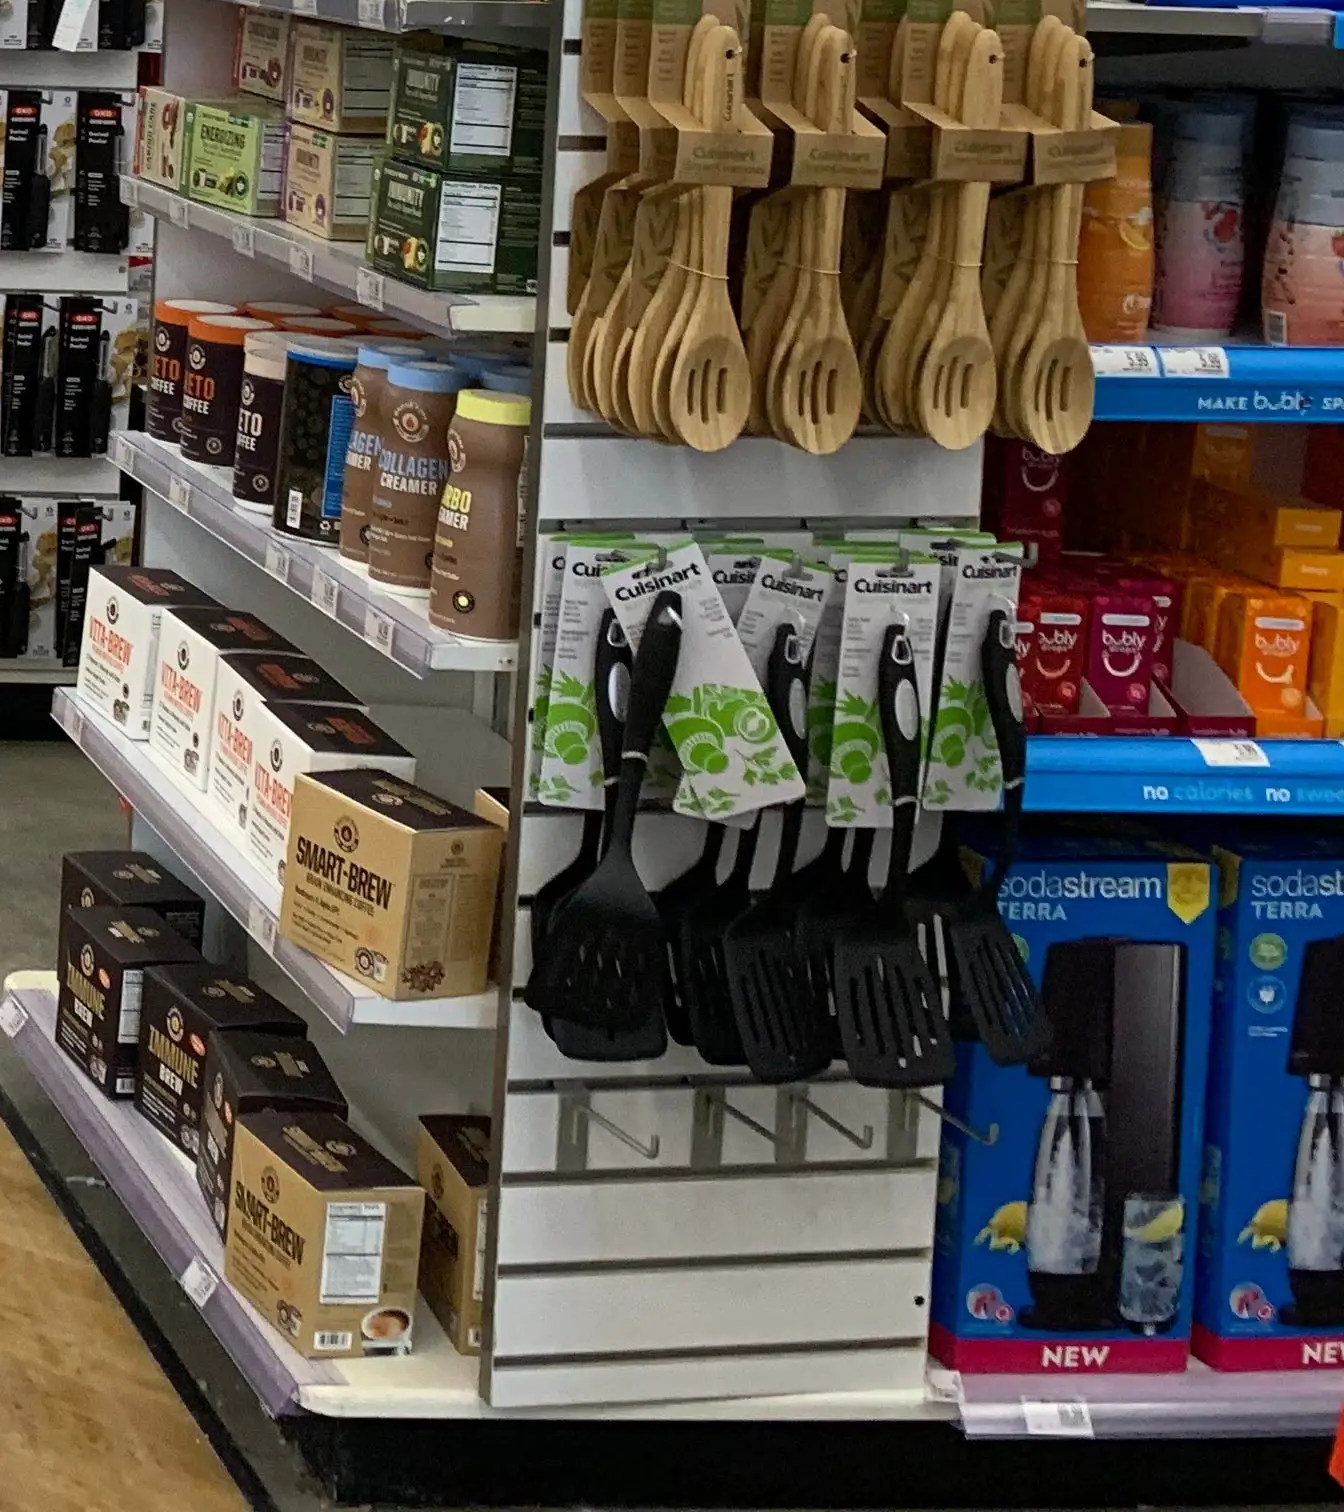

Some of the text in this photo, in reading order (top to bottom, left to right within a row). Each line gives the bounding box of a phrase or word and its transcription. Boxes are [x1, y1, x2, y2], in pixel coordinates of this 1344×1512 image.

[153, 355, 180, 380] ETO
[1198, 396, 1248, 410] MAKE
[380, 473, 437, 496] CREAMER
[615, 562, 701, 601] Cuisinart
[962, 564, 1018, 579] Cuisinart
[761, 574, 824, 602] Cuisinart
[854, 578, 932, 595] Cuisinart
[1103, 629, 1147, 649] bubly
[1255, 633, 1300, 651] bubly
[218, 711, 253, 766] VITA-BRE
[1143, 785, 1169, 800] no
[1174, 781, 1253, 801] calories
[1265, 788, 1291, 802] no
[296, 834, 392, 912] SMART-BREW
[999, 869, 1162, 900] sodastream
[998, 901, 1067, 921] TERRA
[1250, 901, 1324, 920] TERRA
[67, 961, 106, 1020] IMMUNE
[74, 998, 93, 1028] BREW
[148, 1026, 198, 1088] IMMUNE
[159, 1065, 184, 1096] BREW
[235, 1179, 305, 1268] SMART-BREW
[1042, 1344, 1110, 1368] NEW
